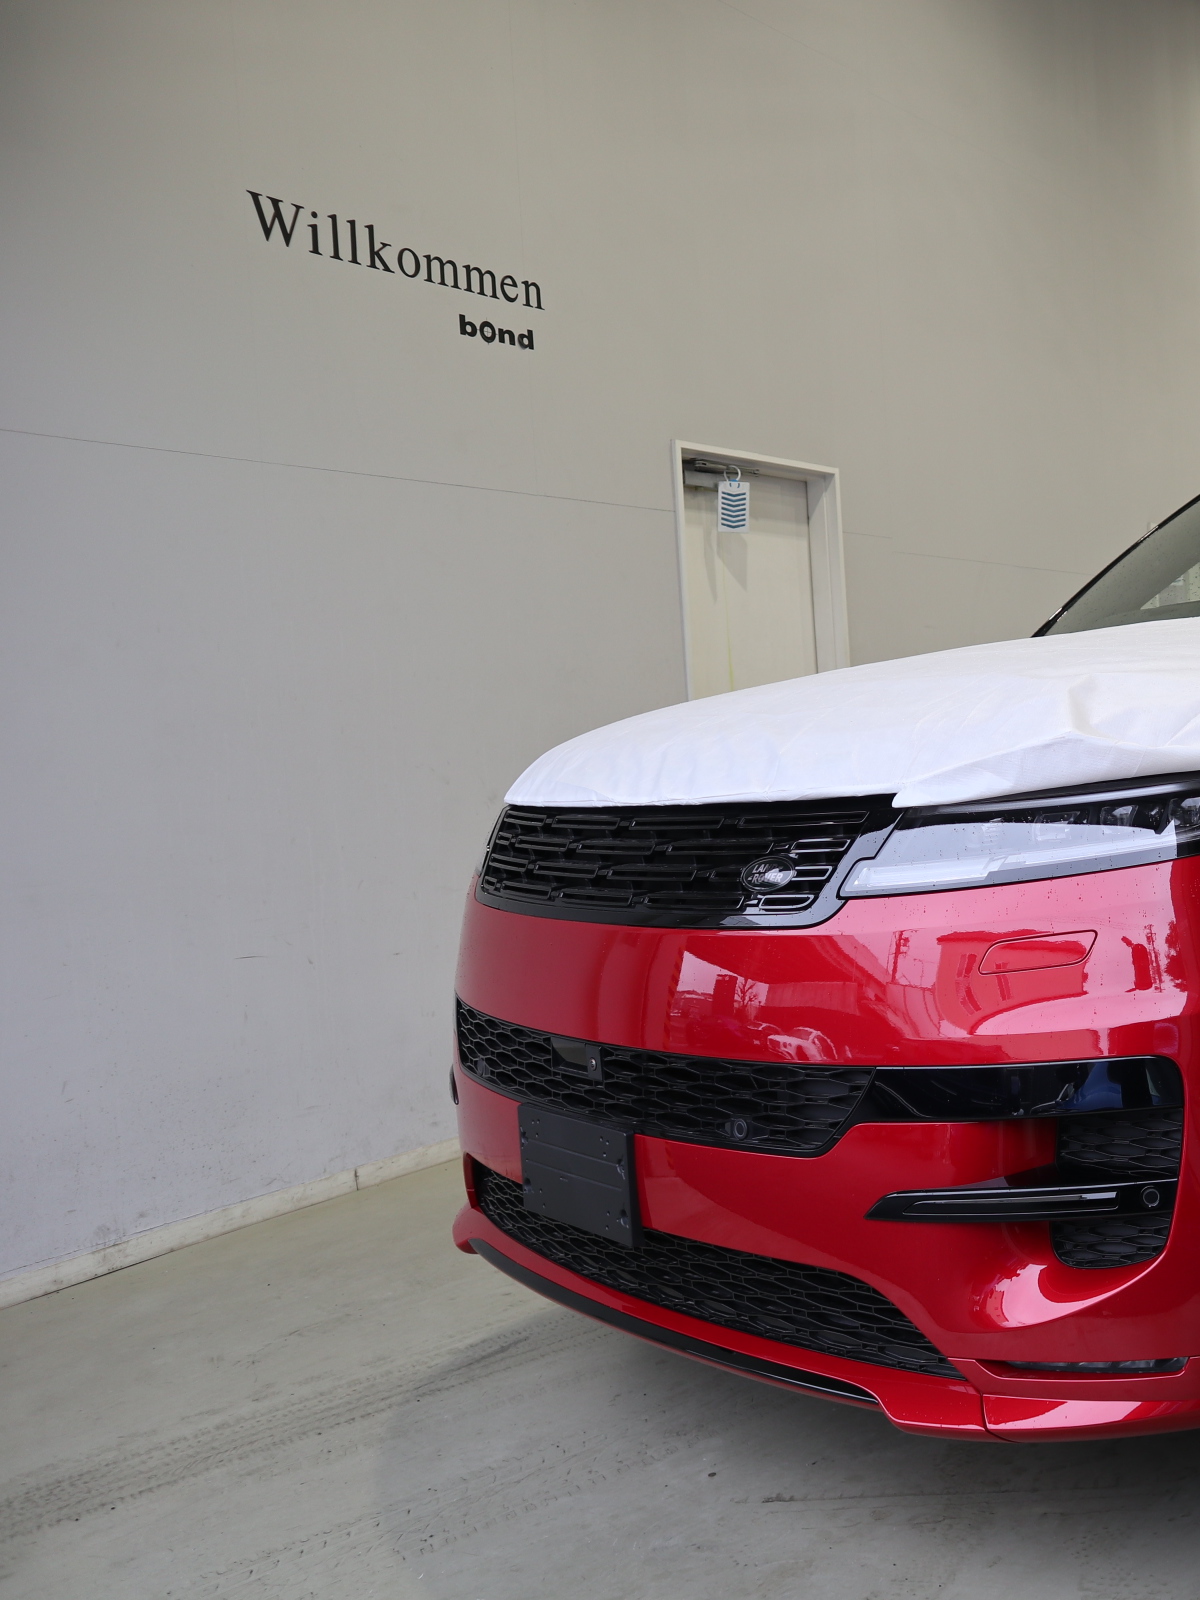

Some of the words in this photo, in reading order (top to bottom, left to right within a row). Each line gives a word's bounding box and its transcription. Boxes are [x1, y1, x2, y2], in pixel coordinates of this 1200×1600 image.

[246, 189, 545, 311] Willkommen
[458, 314, 535, 350] bond
[751, 863, 779, 873] LAND
[751, 873, 784, 884] ROVER
